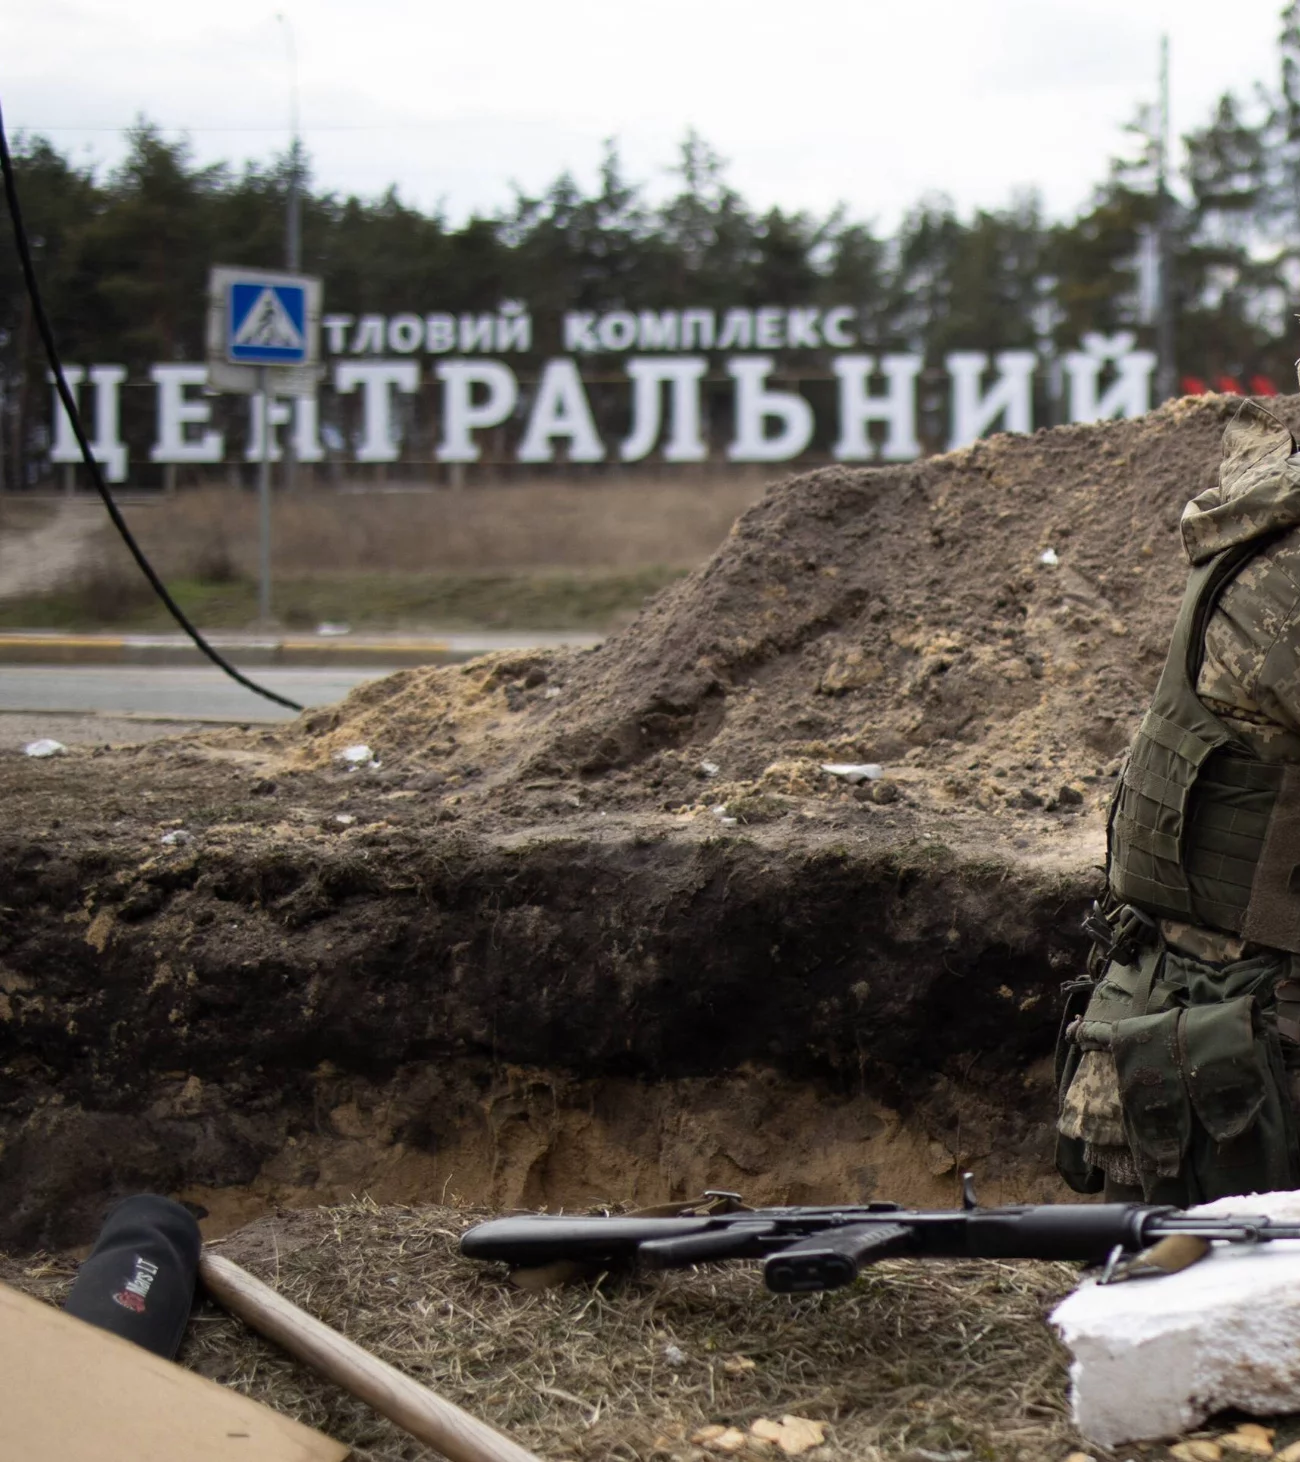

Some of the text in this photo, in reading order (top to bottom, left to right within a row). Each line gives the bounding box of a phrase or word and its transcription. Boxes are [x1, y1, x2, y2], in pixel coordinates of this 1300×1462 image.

[322, 299, 857, 354] ТЛОВИЙ КОМПЛЕКС
[48, 331, 1157, 483] ЦЕНТРАЛЬНИЙ
[125, 1258, 158, 1297] Mars LT
